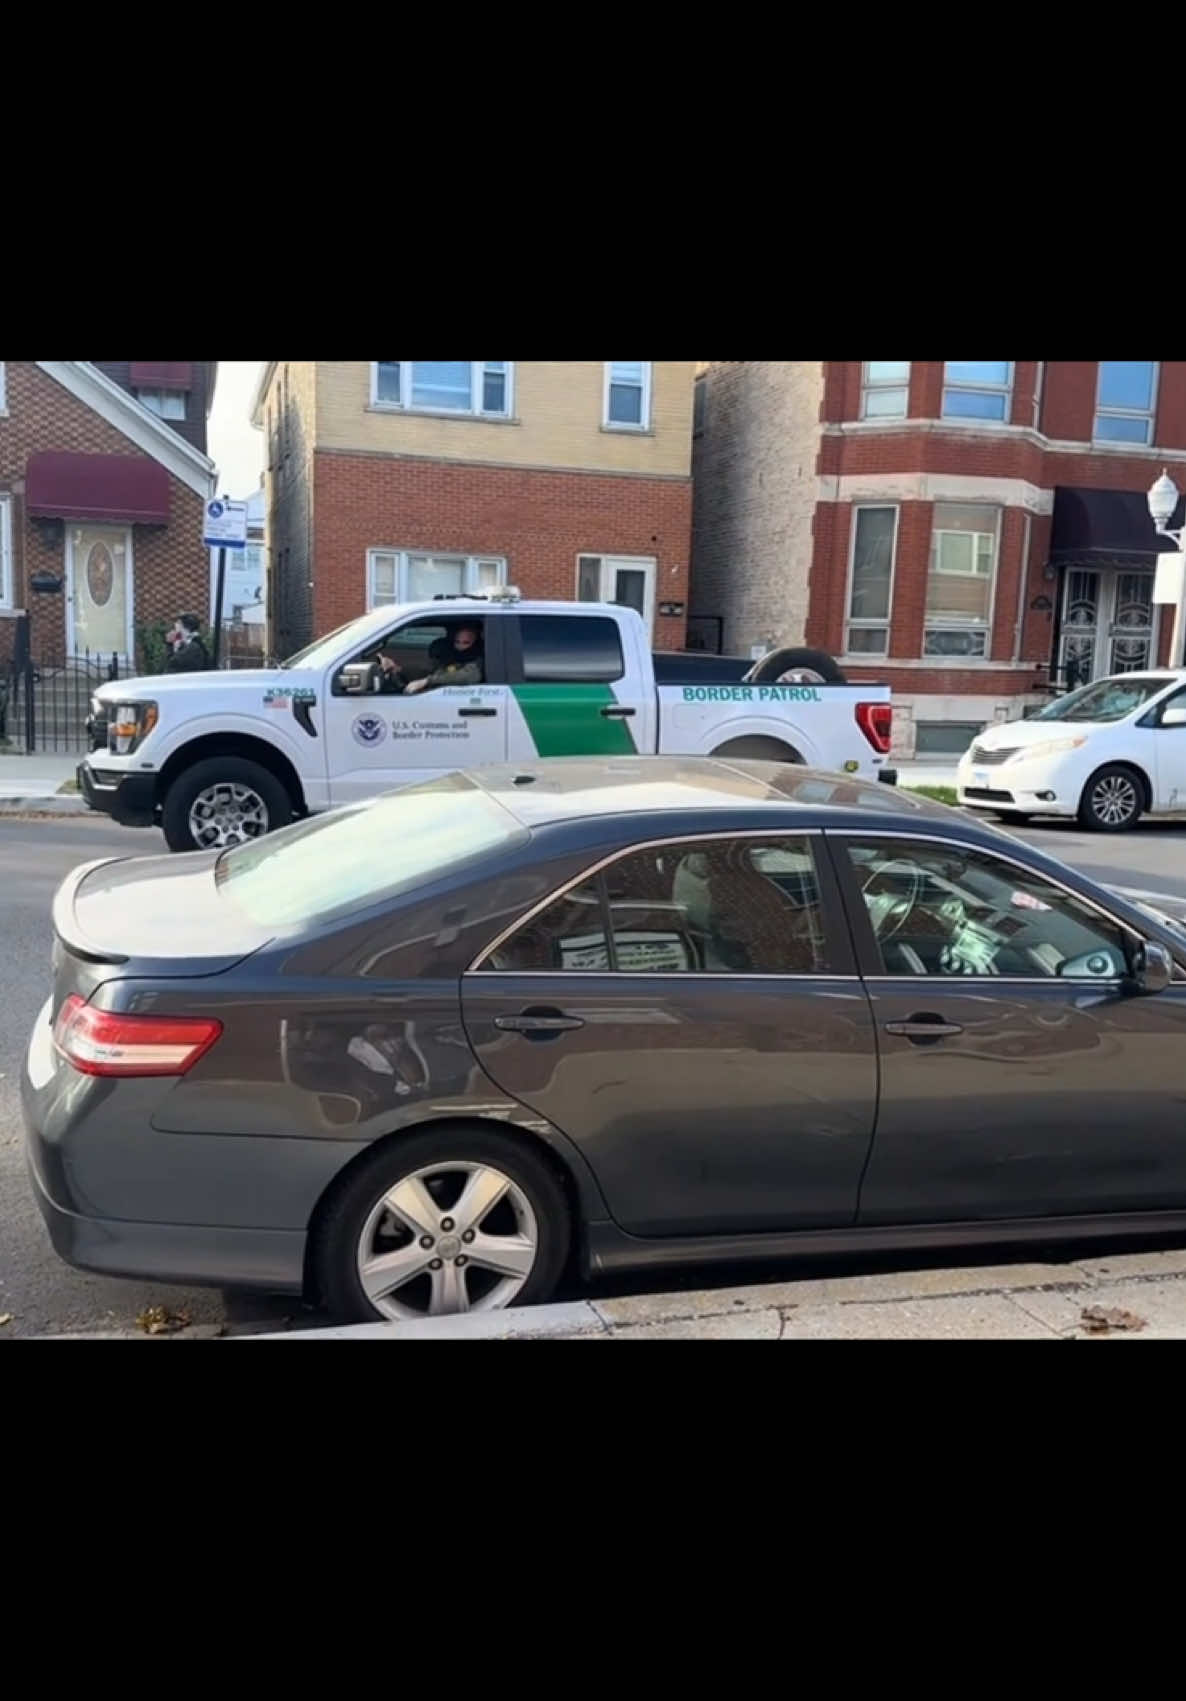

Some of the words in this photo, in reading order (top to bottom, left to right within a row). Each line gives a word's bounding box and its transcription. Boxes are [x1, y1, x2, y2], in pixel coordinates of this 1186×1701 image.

[682, 687, 752, 702] BORDER
[760, 687, 822, 702] PATROL
[392, 720, 410, 730] U.S.
[412, 720, 450, 730] Customs
[452, 720, 468, 730] and
[392, 731, 423, 741] Border
[425, 731, 470, 741] Protection
